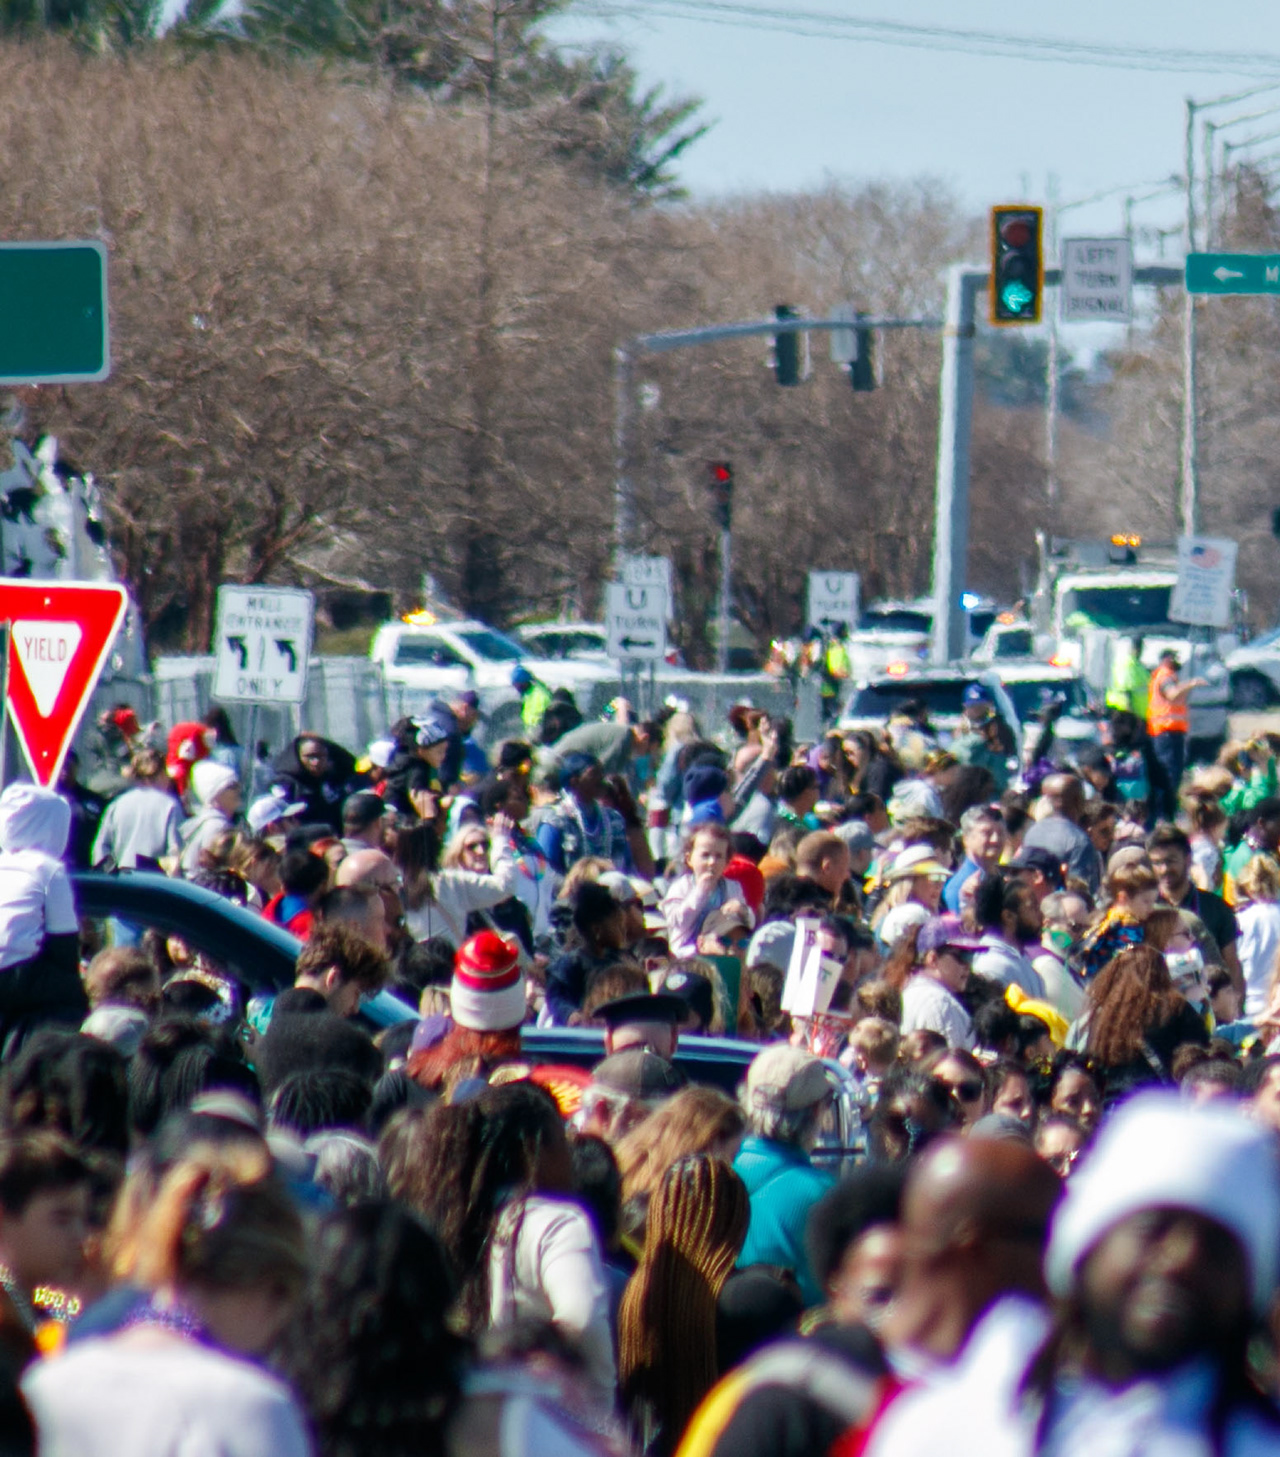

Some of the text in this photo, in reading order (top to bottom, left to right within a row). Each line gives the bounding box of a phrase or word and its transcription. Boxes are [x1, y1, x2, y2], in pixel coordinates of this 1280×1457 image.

[247, 596, 282, 612] MALL
[625, 589, 648, 610] U
[24, 636, 67, 662] YIELD
[236, 677, 284, 695] ONLY
